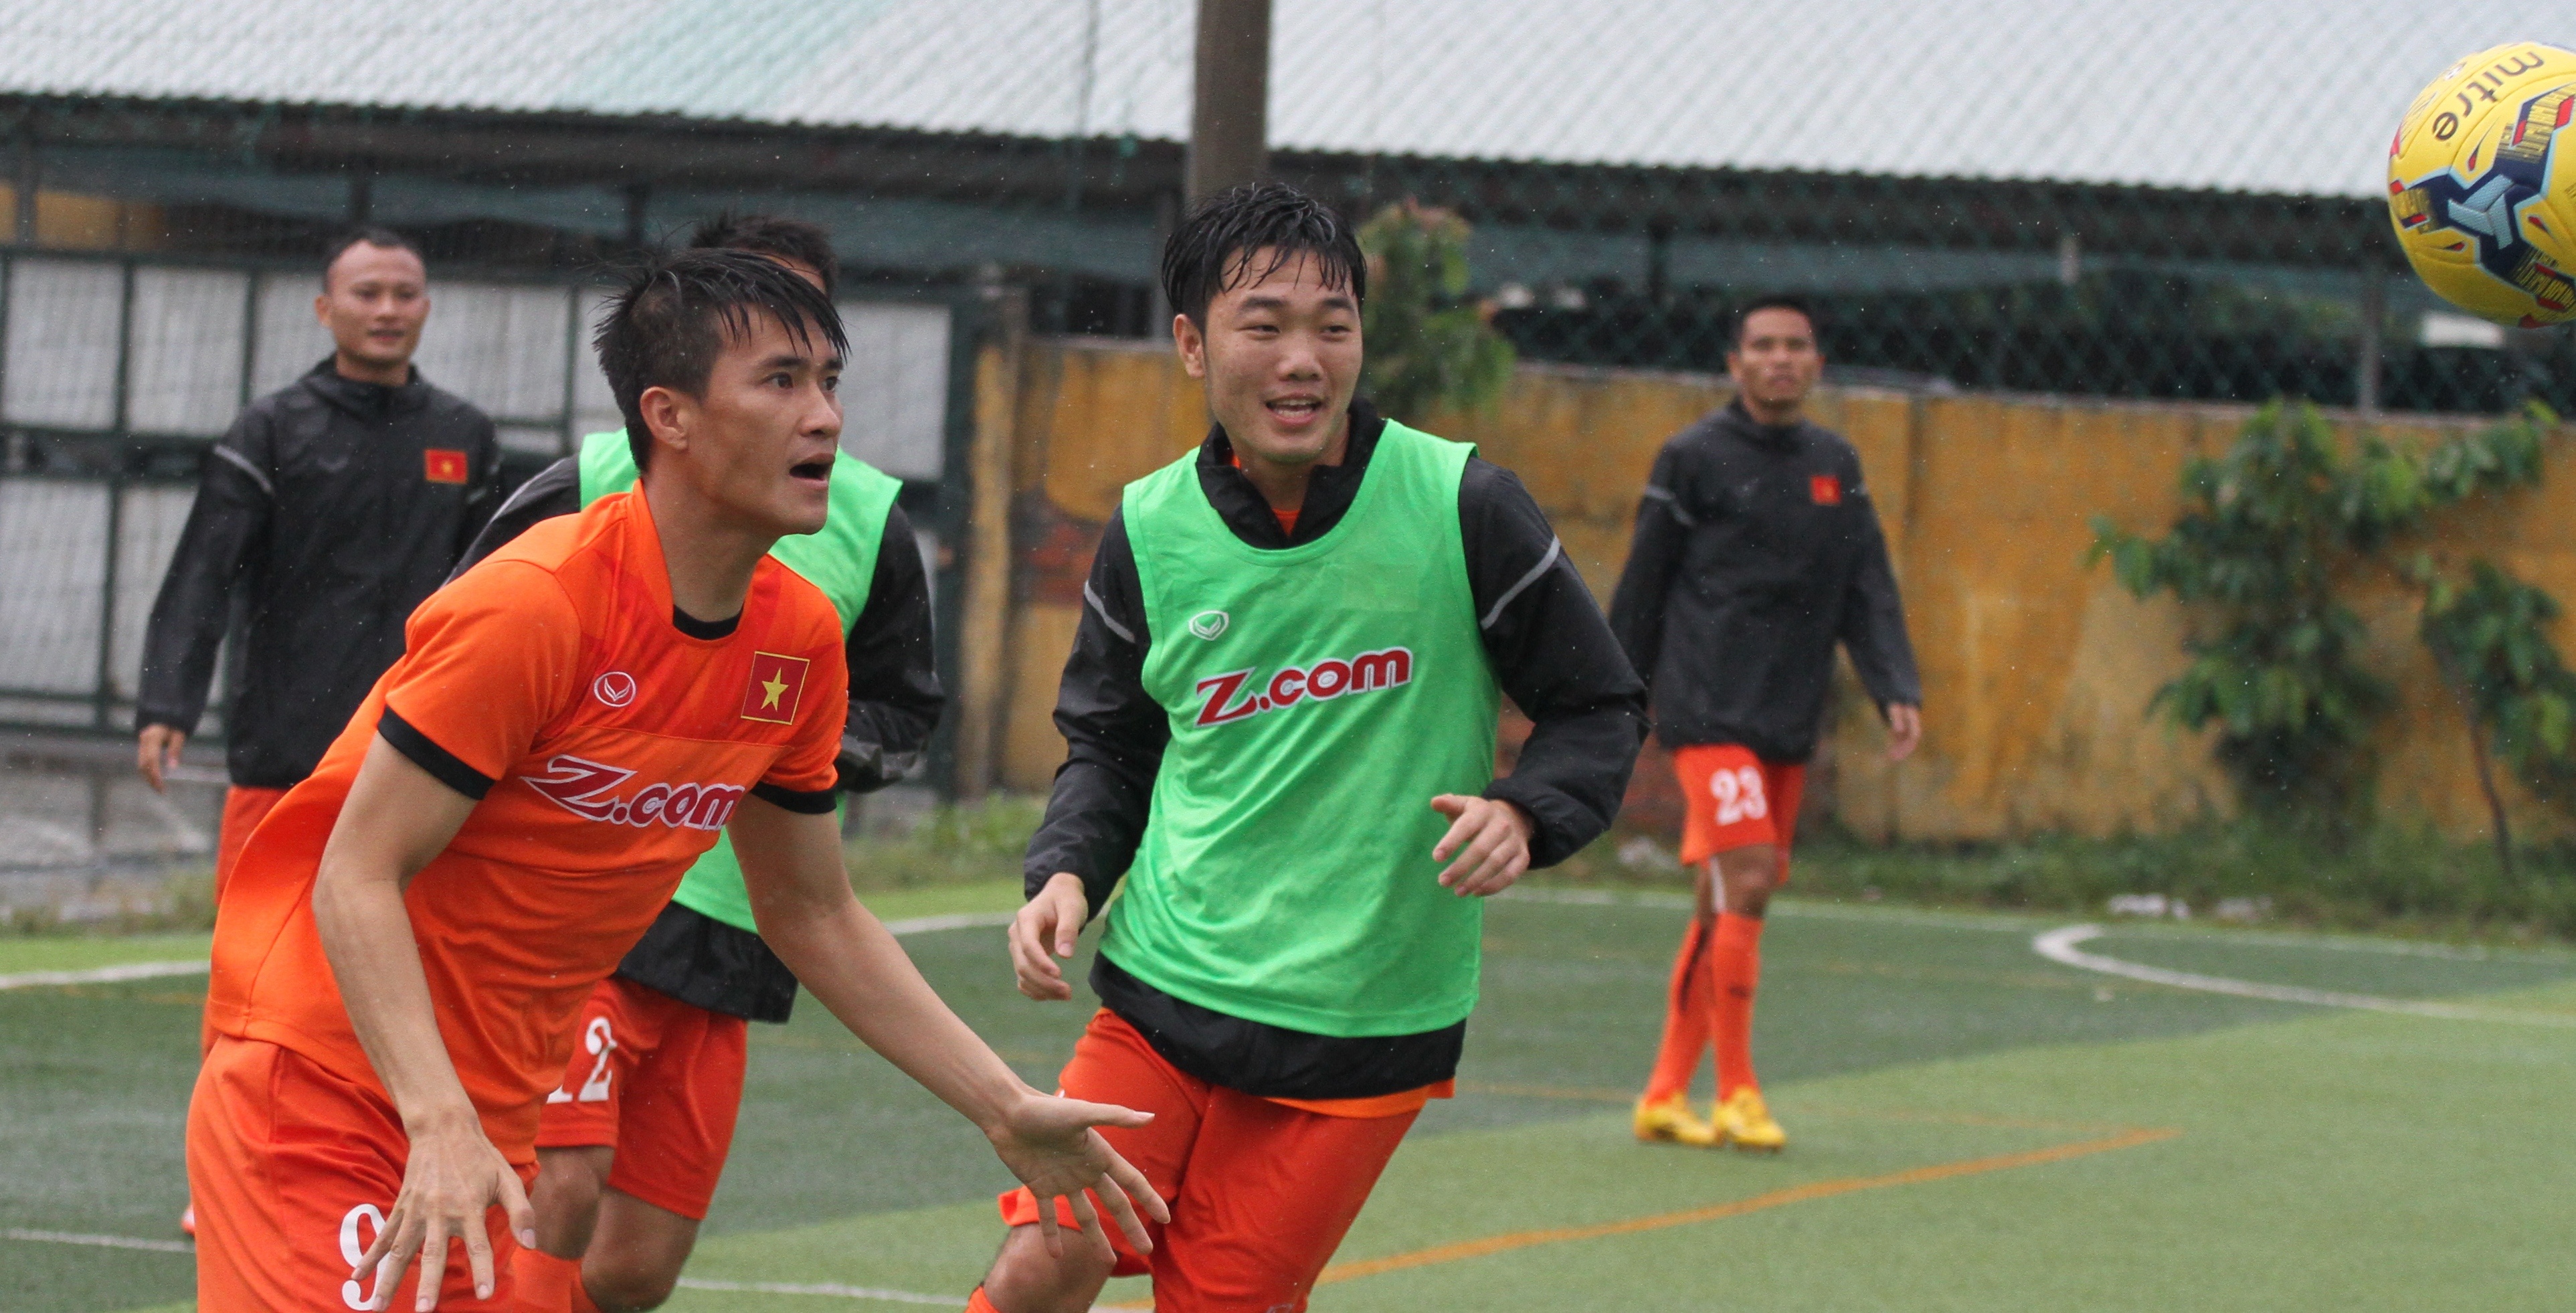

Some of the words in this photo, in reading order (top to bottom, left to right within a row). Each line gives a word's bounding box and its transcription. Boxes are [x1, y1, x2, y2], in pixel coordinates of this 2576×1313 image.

[2431, 51, 2545, 142] mitre
[1194, 646, 1413, 728] Z.com
[519, 754, 745, 830] Z.com
[1710, 764, 1768, 826] 23
[547, 1017, 617, 1104] 2
[339, 1203, 391, 1311] 9
